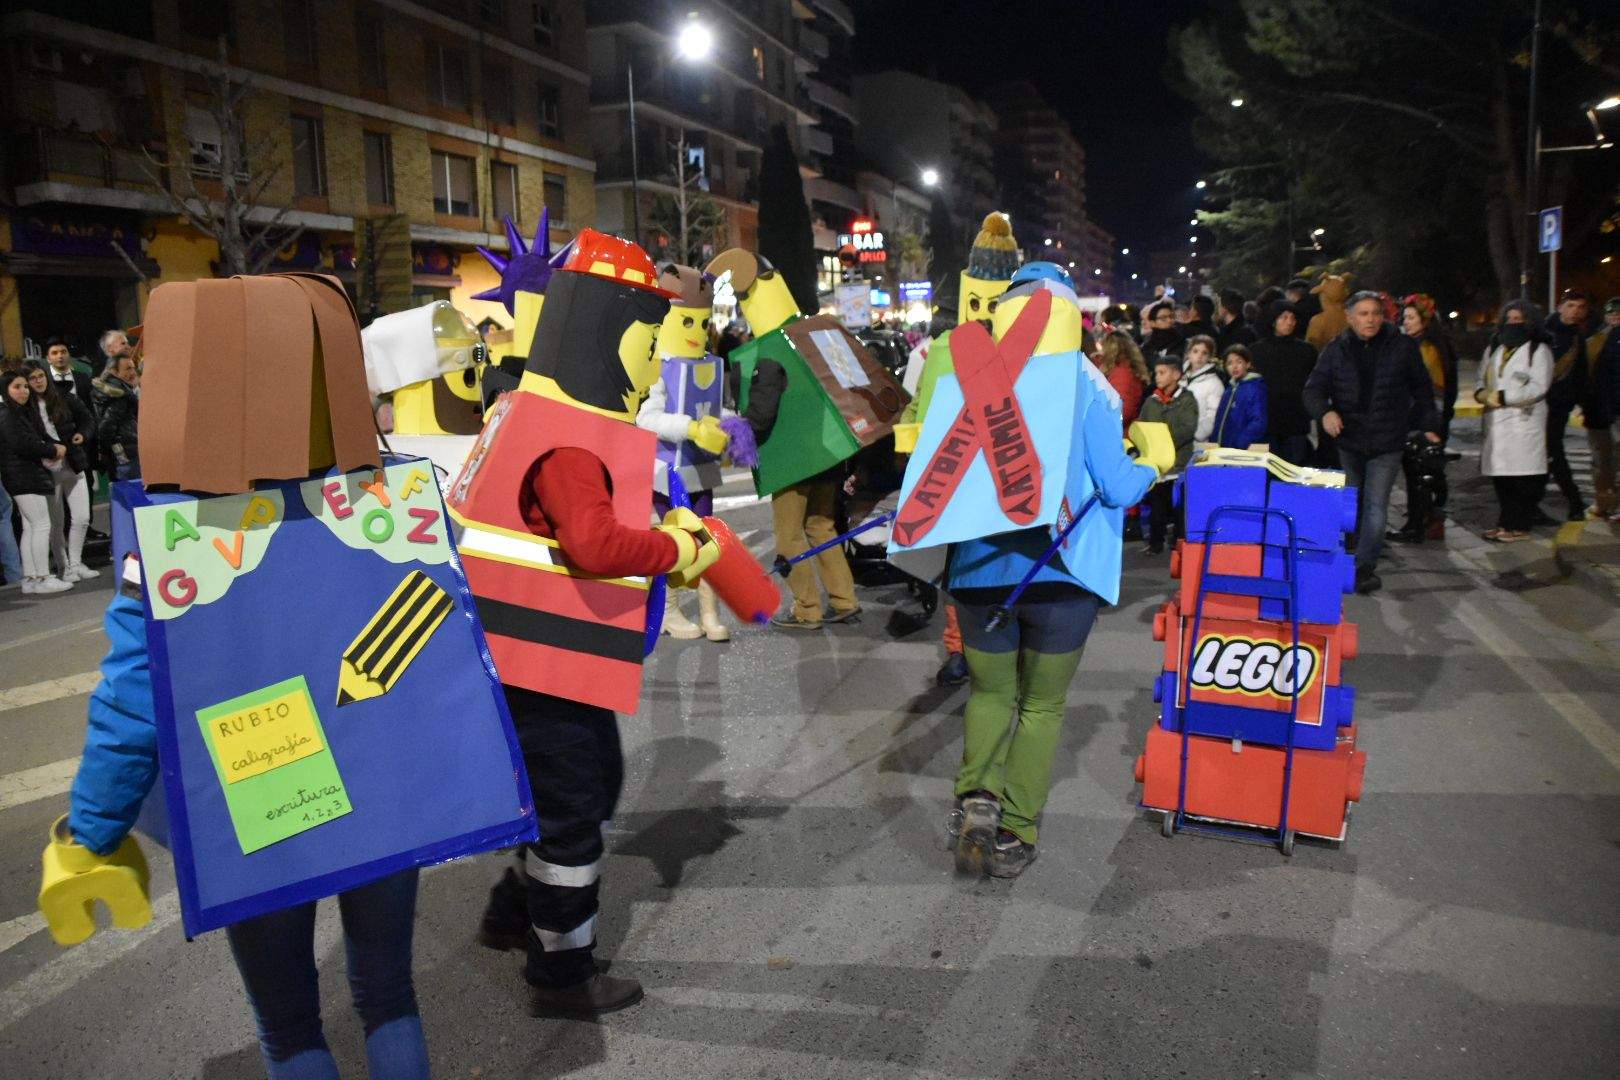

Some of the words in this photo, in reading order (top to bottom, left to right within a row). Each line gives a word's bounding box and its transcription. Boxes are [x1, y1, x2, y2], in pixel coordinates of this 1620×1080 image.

[853, 232, 883, 250] BAR
[1543, 214, 1556, 246] P
[984, 397, 1035, 498] ATOMIC
[321, 481, 353, 521] E
[359, 471, 391, 509] Y
[400, 469, 429, 501] F
[165, 509, 200, 551] A
[240, 496, 277, 531] P
[362, 508, 394, 544] O
[407, 507, 440, 544] Z
[212, 531, 244, 570] V
[158, 568, 198, 608] G
[1191, 638, 1315, 696] LEGO
[219, 702, 289, 738] RUBIO
[265, 785, 341, 821] escritura
